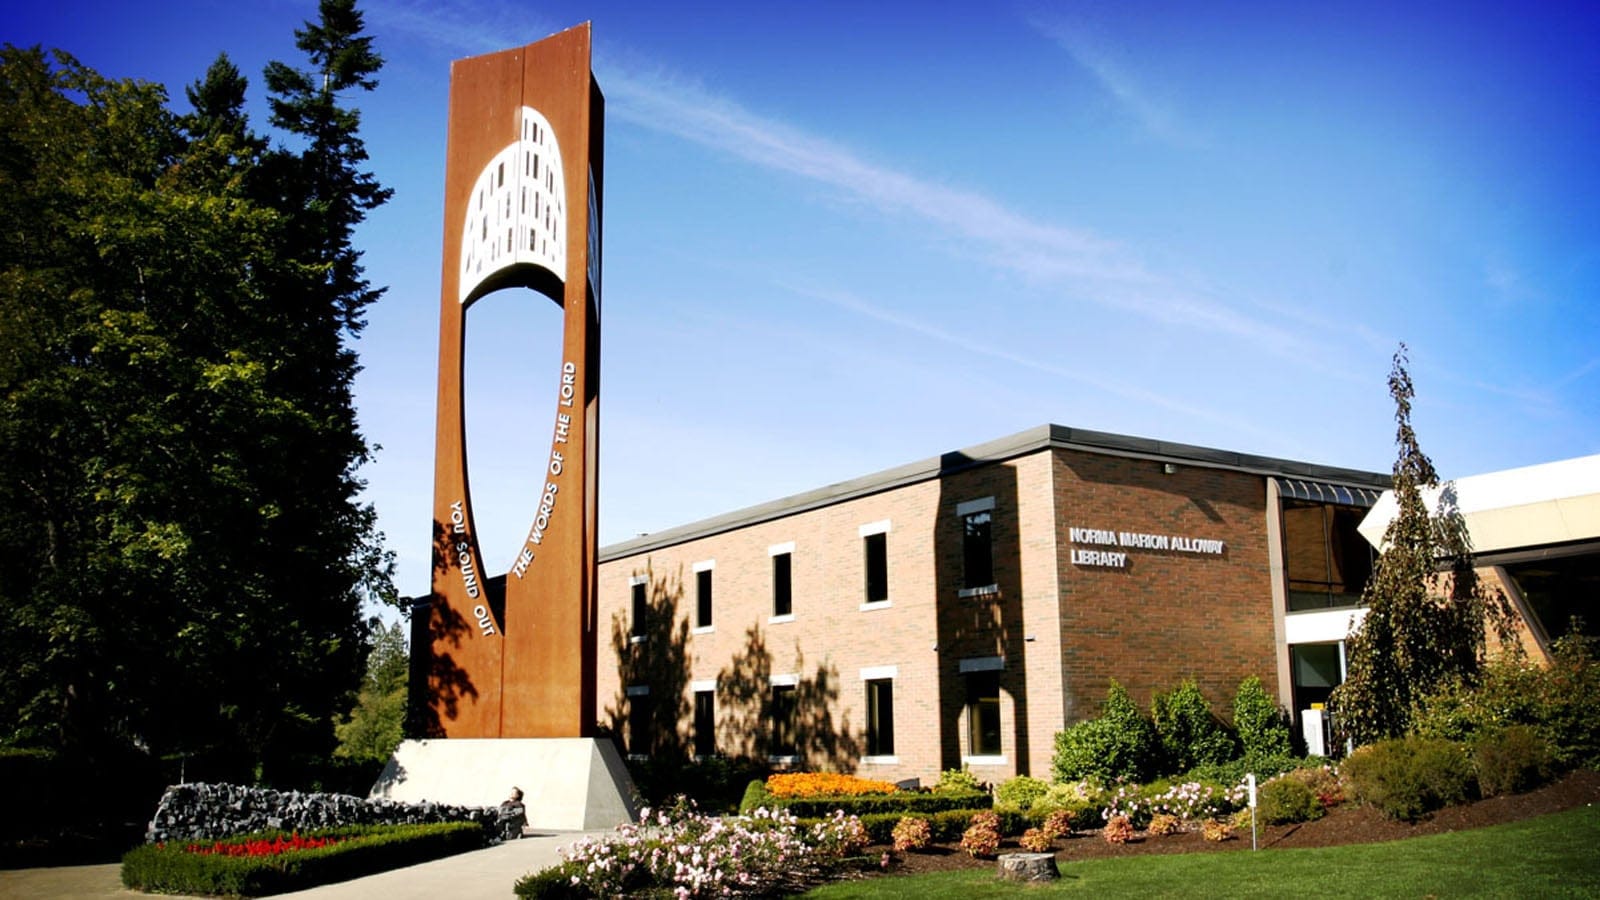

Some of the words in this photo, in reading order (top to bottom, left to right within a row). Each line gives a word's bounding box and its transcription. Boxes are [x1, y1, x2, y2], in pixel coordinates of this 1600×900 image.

[560, 361, 575, 407] LORD
[555, 413, 571, 444] THE
[550, 450, 563, 475] OF
[450, 501, 465, 534] YOU
[530, 482, 558, 545] WORDS
[1069, 527, 1117, 545] NORMA
[1119, 532, 1169, 549] MARION
[1171, 537, 1224, 554] ALLOWAY
[457, 542, 479, 598] SOUND
[512, 547, 534, 579] THE
[1070, 549, 1127, 568] LIBRARY
[474, 605, 496, 636] OUT
